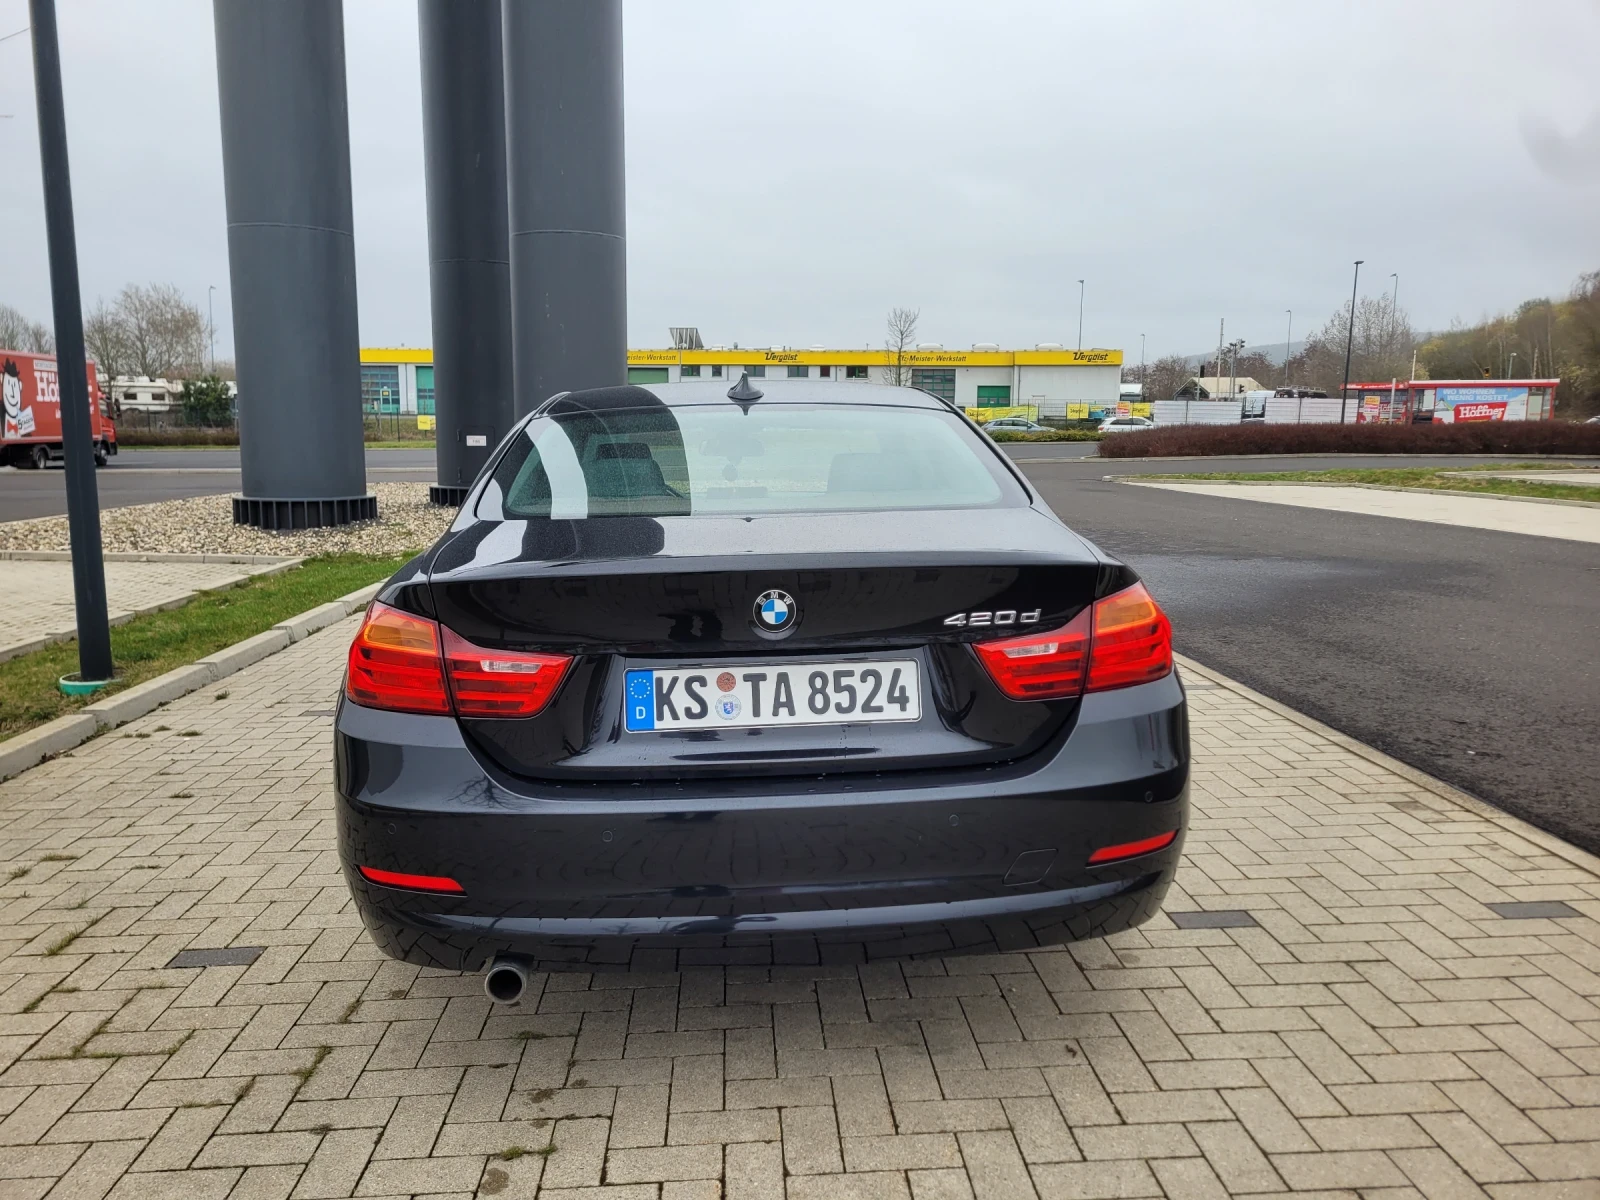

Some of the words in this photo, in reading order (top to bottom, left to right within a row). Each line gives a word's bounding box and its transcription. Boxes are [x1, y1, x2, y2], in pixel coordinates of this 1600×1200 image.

[765, 352, 798, 363] Vergölst
[1073, 352, 1109, 363] Vergölst
[1459, 405, 1505, 418] Höffner
[757, 591, 793, 606] BMW
[654, 674, 709, 722] KS
[742, 671, 796, 718] TA
[807, 667, 910, 715] 8524
[636, 706, 647, 720] D
